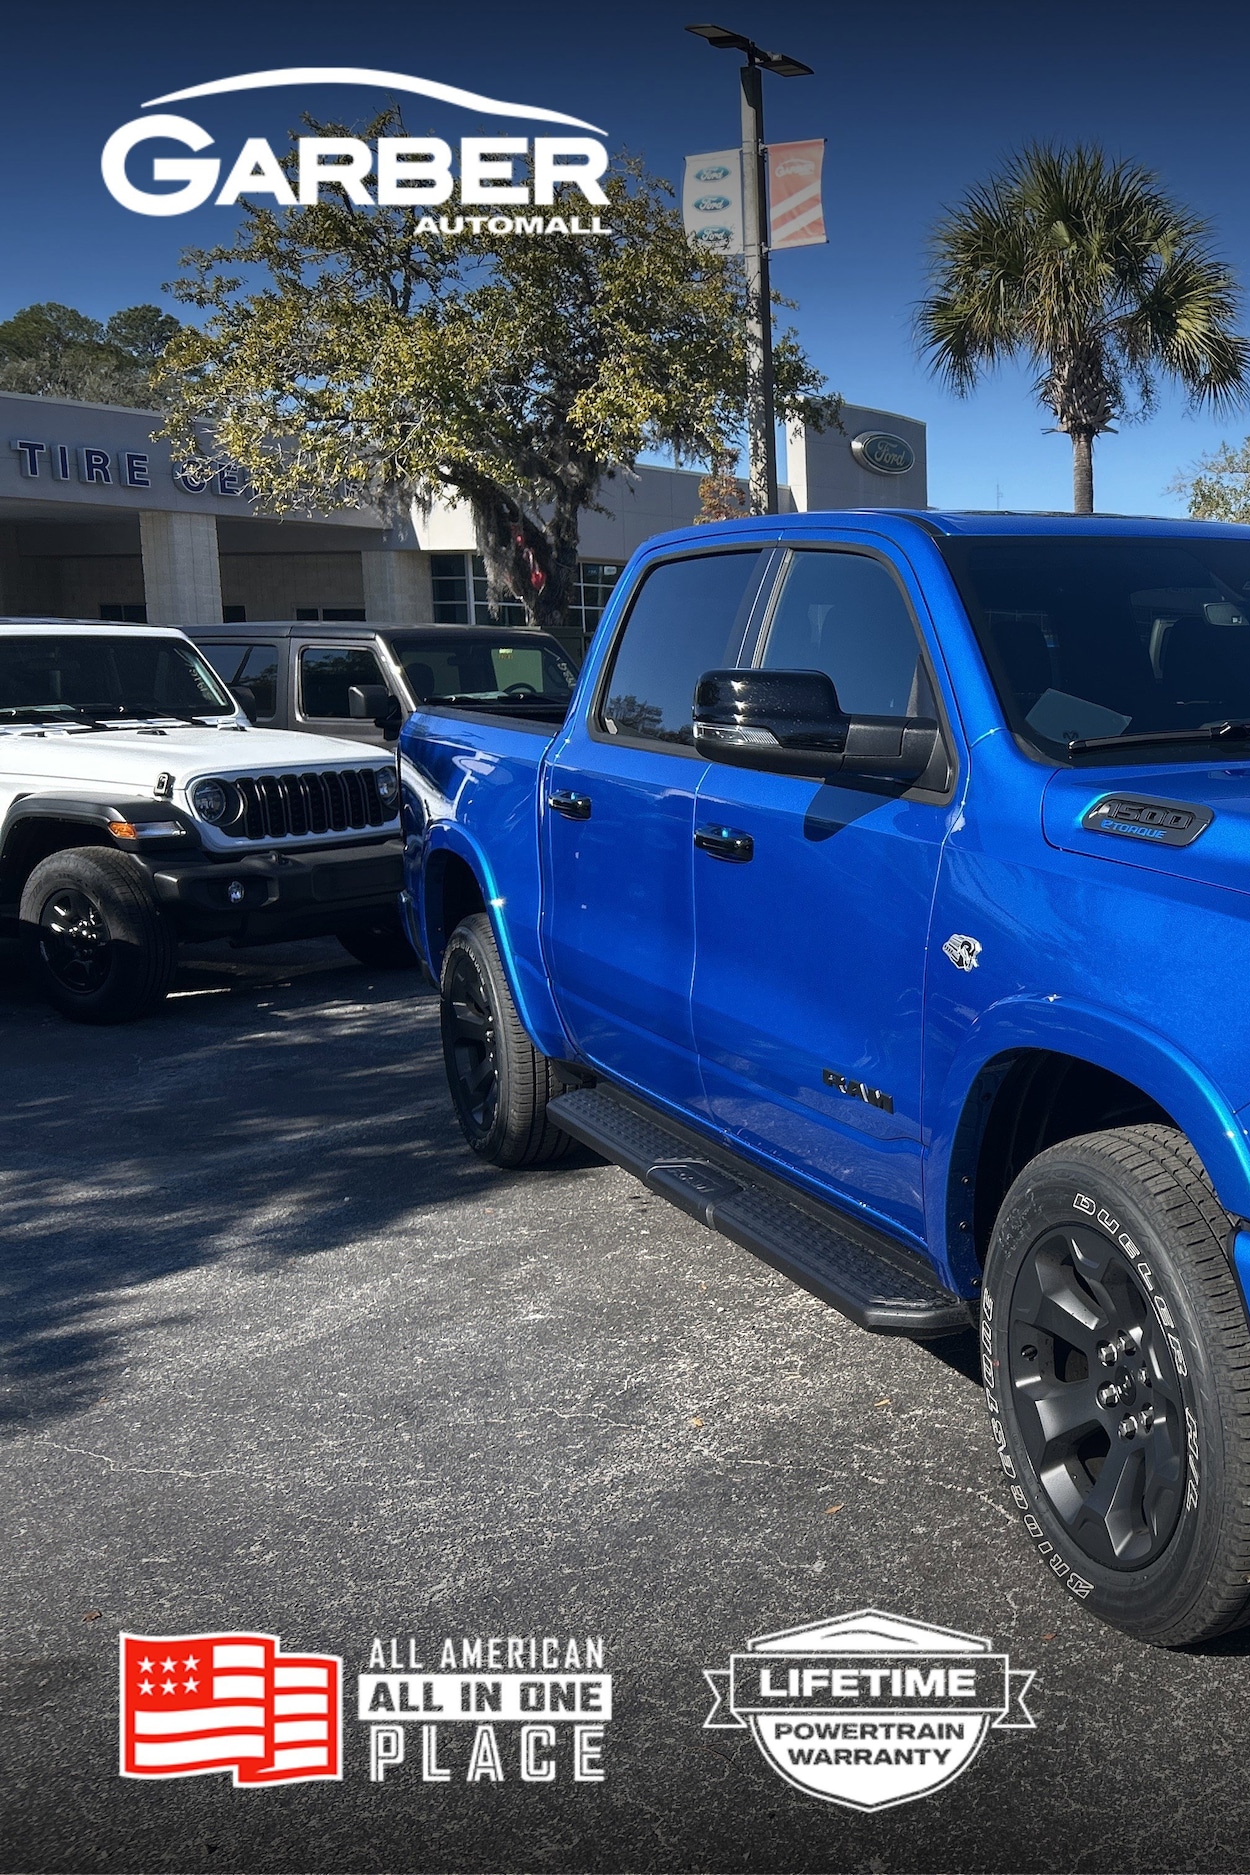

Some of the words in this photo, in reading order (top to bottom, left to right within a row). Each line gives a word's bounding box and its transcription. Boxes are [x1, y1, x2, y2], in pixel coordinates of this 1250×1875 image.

[16, 440, 151, 488] TIRE
[874, 440, 906, 466] Ford
[1103, 801, 1192, 828] 1500
[822, 1067, 894, 1115] RAM
[981, 1287, 1096, 1600] BRIDGESTONE
